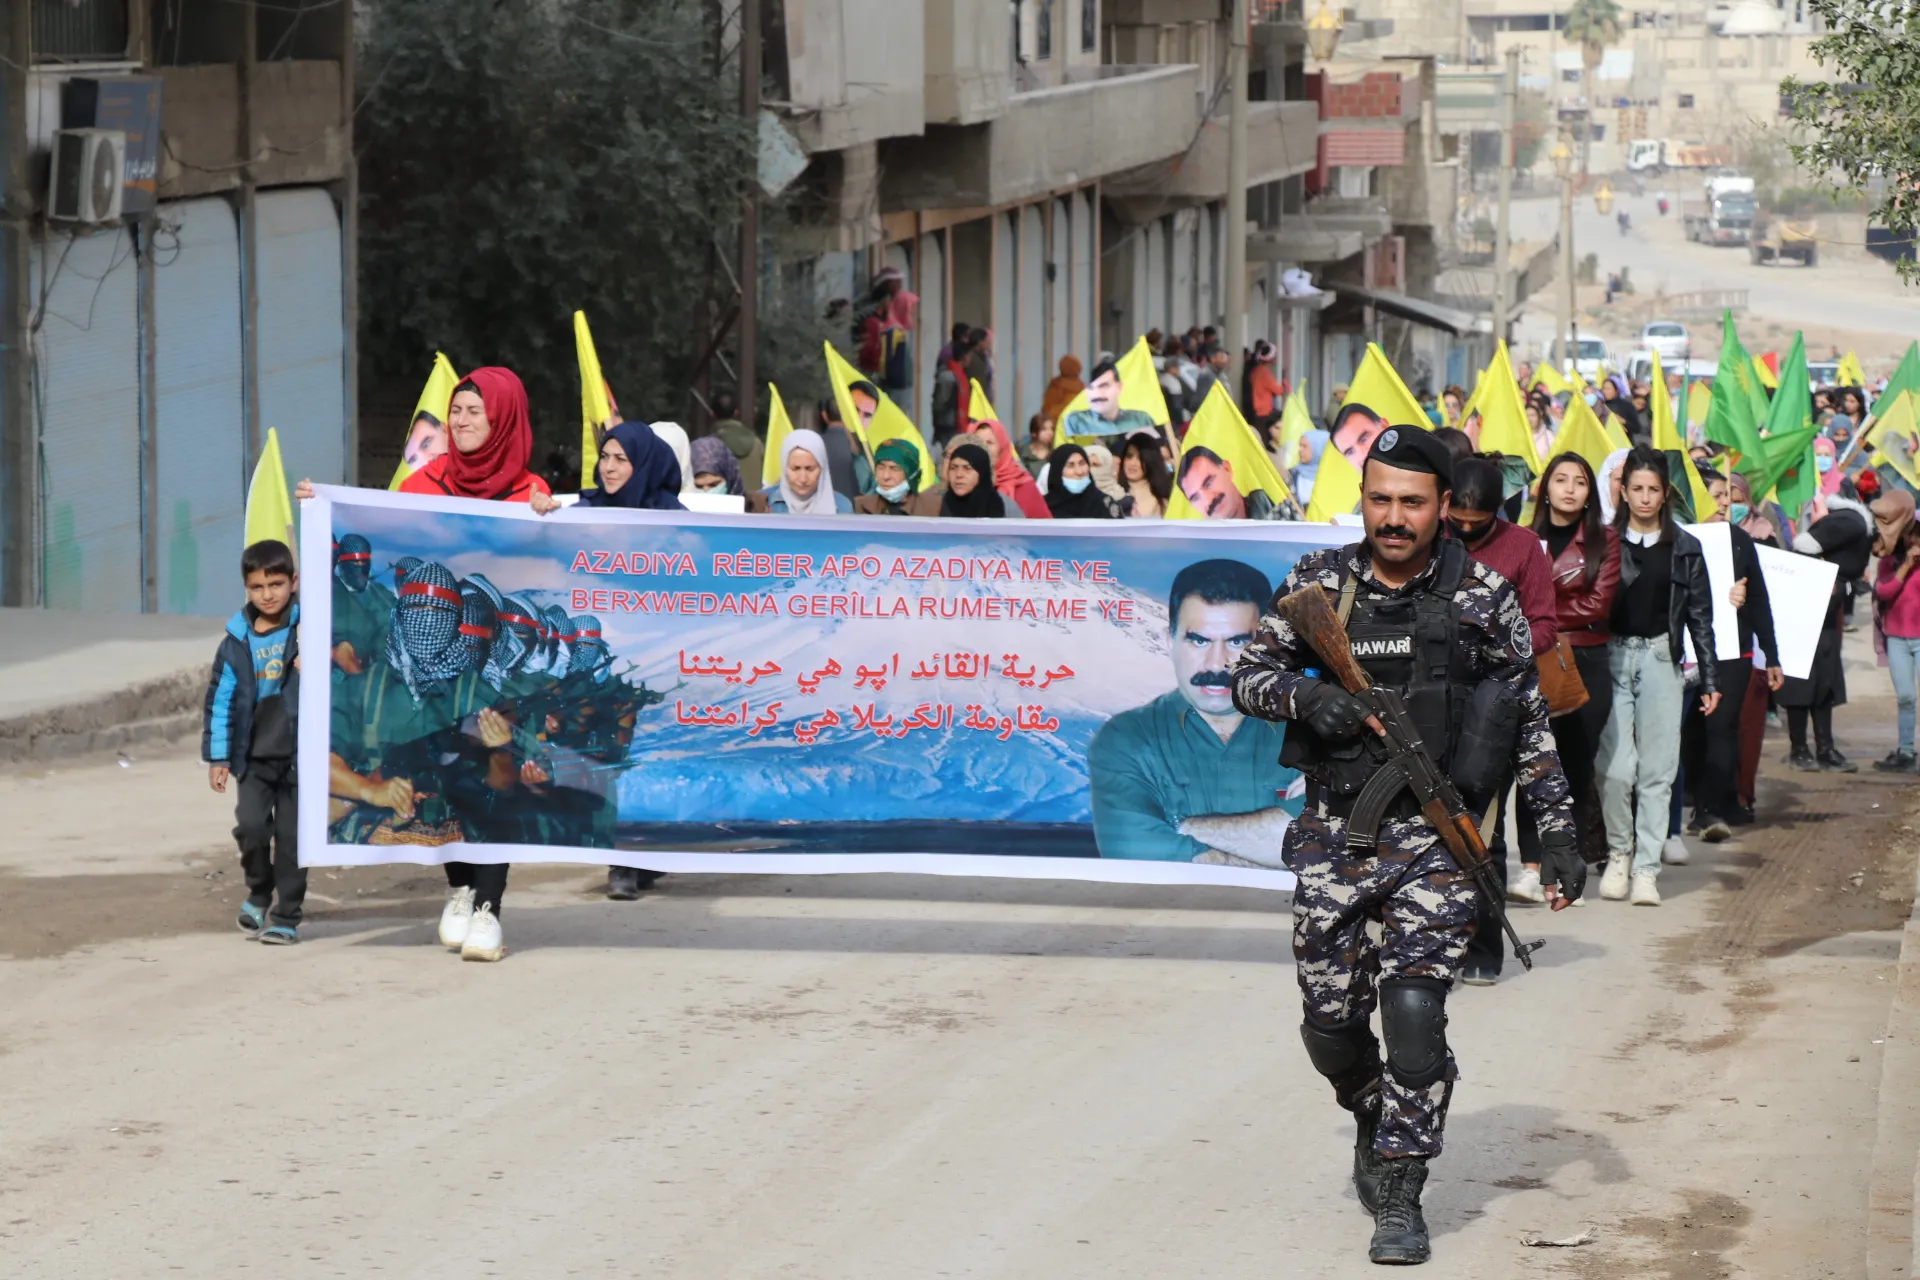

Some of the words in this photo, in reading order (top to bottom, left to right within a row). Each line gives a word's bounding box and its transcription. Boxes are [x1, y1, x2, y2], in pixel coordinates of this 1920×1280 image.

[571, 550, 697, 575] AZADIYA
[713, 549, 813, 577] RÊBER
[820, 555, 882, 578] APO
[889, 556, 1012, 580] AZADIYA
[1021, 559, 1063, 581] ME
[1072, 560, 1118, 583] YE.
[571, 588, 779, 616] BERXWEDANA
[787, 590, 910, 617] GERÎLLA
[918, 596, 1038, 619] RUMETA
[1046, 598, 1088, 620] ME
[1097, 599, 1143, 622] YE.
[1350, 636, 1412, 656] HAWARÎ
[678, 648, 783, 687] حريتنا
[796, 657, 843, 695] هي
[910, 651, 992, 680] القائد
[1001, 652, 1076, 689] حرية
[675, 699, 783, 737] كرامتنا
[794, 708, 841, 745] هي
[964, 703, 1060, 741] مقاومة
